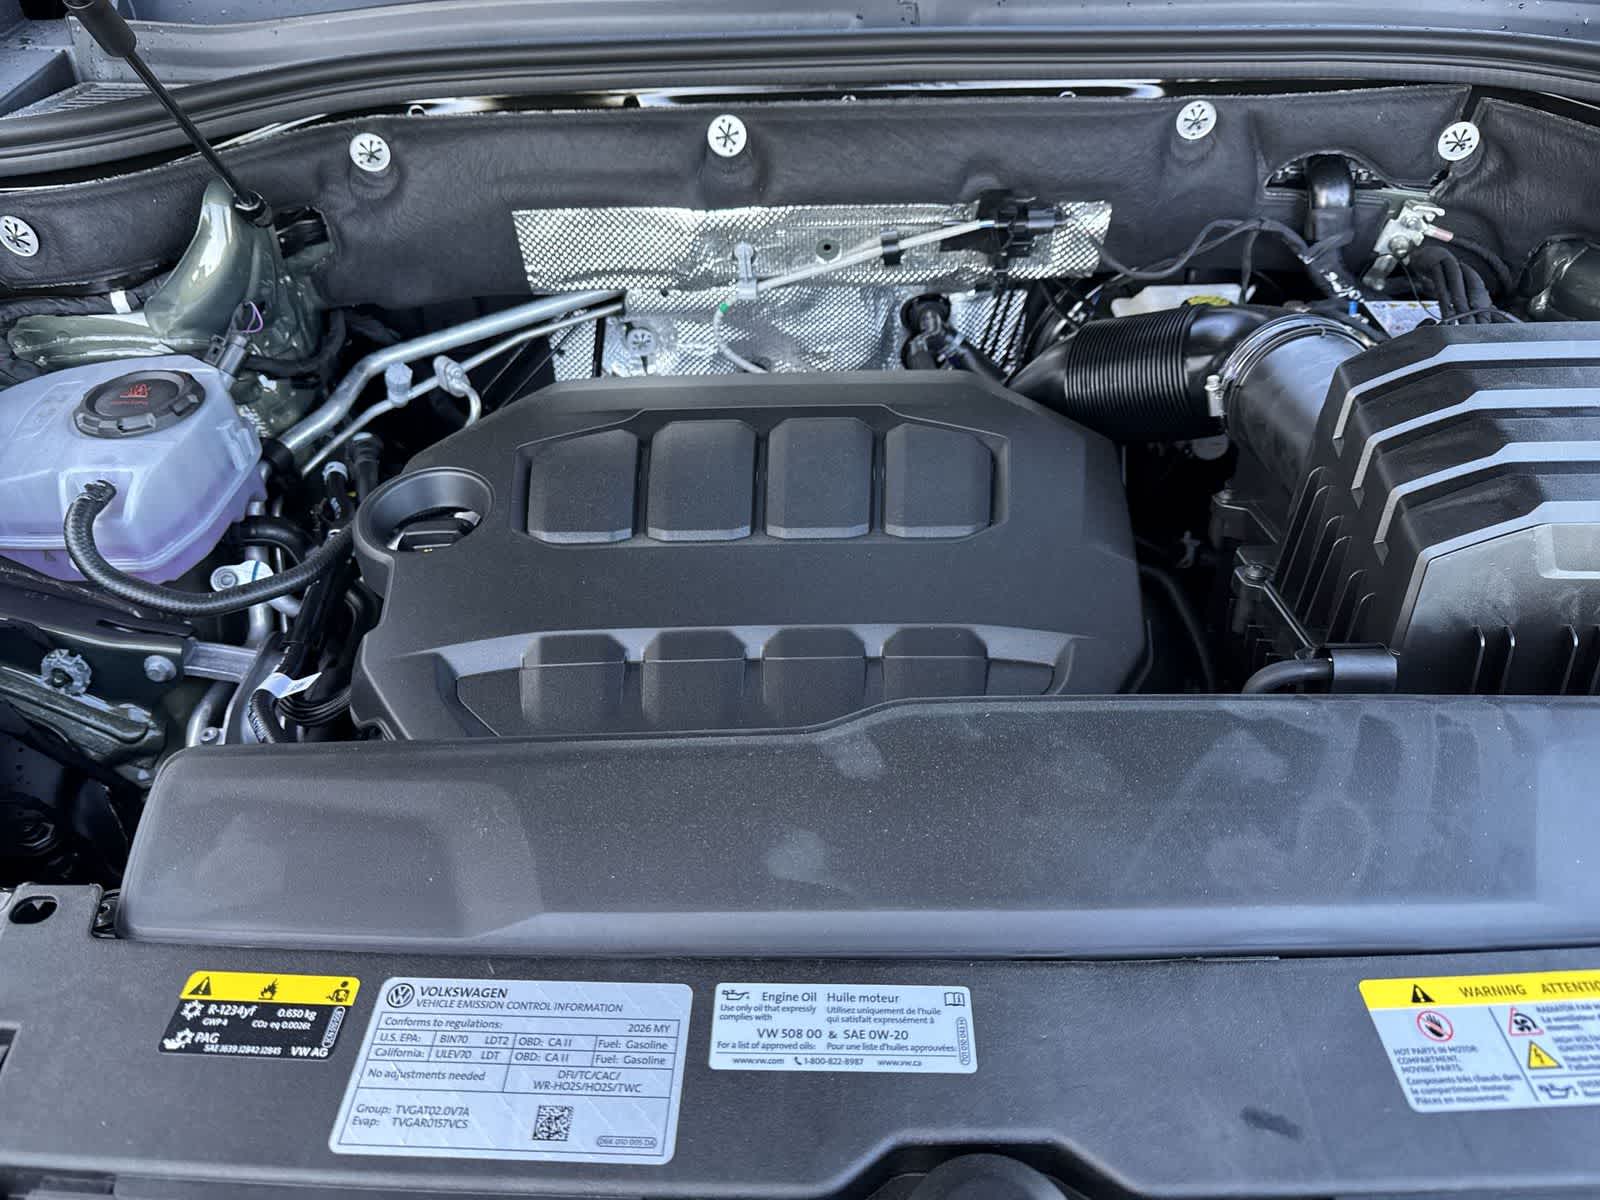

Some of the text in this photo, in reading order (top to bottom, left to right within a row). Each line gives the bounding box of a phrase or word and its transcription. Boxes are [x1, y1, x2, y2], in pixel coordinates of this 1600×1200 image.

[420, 986, 508, 998] VOLKSWAGEN
[762, 991, 817, 1004] Engine Oil
[1458, 984, 1527, 999] WARNING
[827, 992, 900, 1004] Huile moteur
[207, 1003, 317, 1021] R-1234yf 0.650 kg
[416, 999, 624, 1013] VEHICLE EMISSION CONTROL INFORMATION
[720, 1004, 817, 1014] Use only oil that expressly
[827, 1006, 856, 1015] Utilisez
[857, 1007, 905, 1017] uniquement
[908, 1008, 917, 1016] de
[385, 1017, 503, 1030] Conforms to regulations:
[719, 1013, 772, 1022] complies with
[826, 1016, 840, 1025] qui
[841, 1015, 872, 1023] satisfait
[873, 1016, 928, 1026] expressément
[269, 1021, 281, 1031] eq
[627, 1023, 671, 1034] 2026 MY
[194, 1031, 220, 1044] PAG
[757, 1028, 909, 1040] VW 508 00 & SAE 0W-20
[380, 1033, 397, 1042] U.S.
[401, 1033, 421, 1042] EPA:
[439, 1034, 469, 1044] BIN70
[485, 1036, 509, 1045] LDT2
[519, 1037, 543, 1047] OBD:
[598, 1039, 622, 1049] Fuel:
[625, 1040, 669, 1050] Gasoline
[717, 1041, 730, 1049] For
[738, 1041, 750, 1049] list
[751, 1041, 760, 1049] of
[761, 1041, 798, 1051] approved
[826, 1042, 845, 1050] Pour
[846, 1043, 861, 1051] une
[862, 1042, 878, 1051] liste
[291, 1046, 311, 1057] VW
[310, 1047, 328, 1058] AG
[375, 1048, 425, 1058] California:
[435, 1050, 472, 1060] ULEV70
[481, 1050, 501, 1060] LDT
[514, 1052, 541, 1062] OBD:
[595, 1054, 619, 1065] Fuel:
[623, 1055, 666, 1066] Gasoline
[367, 1068, 486, 1081] No adjustments needed
[356, 1103, 391, 1115] Group:
[351, 1115, 380, 1128] Evap:
